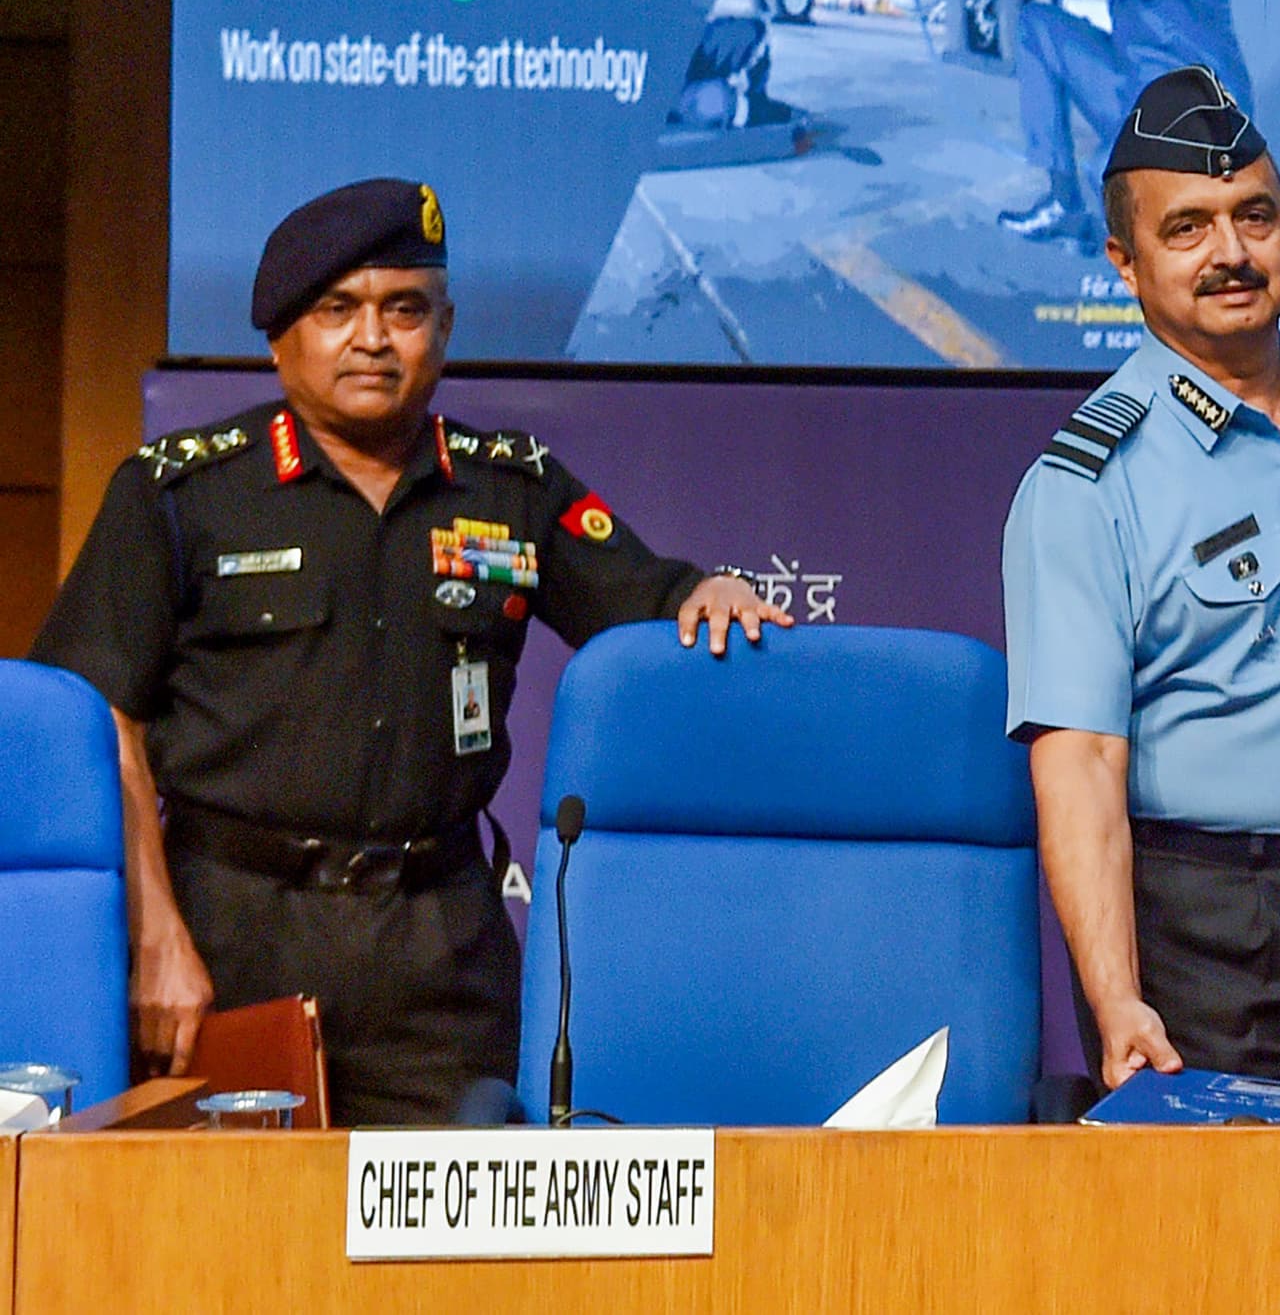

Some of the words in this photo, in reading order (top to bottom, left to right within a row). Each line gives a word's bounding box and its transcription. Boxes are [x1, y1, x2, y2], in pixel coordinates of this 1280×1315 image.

[221, 28, 286, 83] Work
[289, 45, 320, 84] on
[323, 32, 511, 89] state-of-the-art
[513, 36, 648, 103] technology
[360, 1160, 437, 1228] CHIEF
[445, 1160, 479, 1228] OF
[487, 1160, 538, 1228] THE
[543, 1159, 619, 1227] ARMY
[626, 1159, 705, 1227] STAFF
